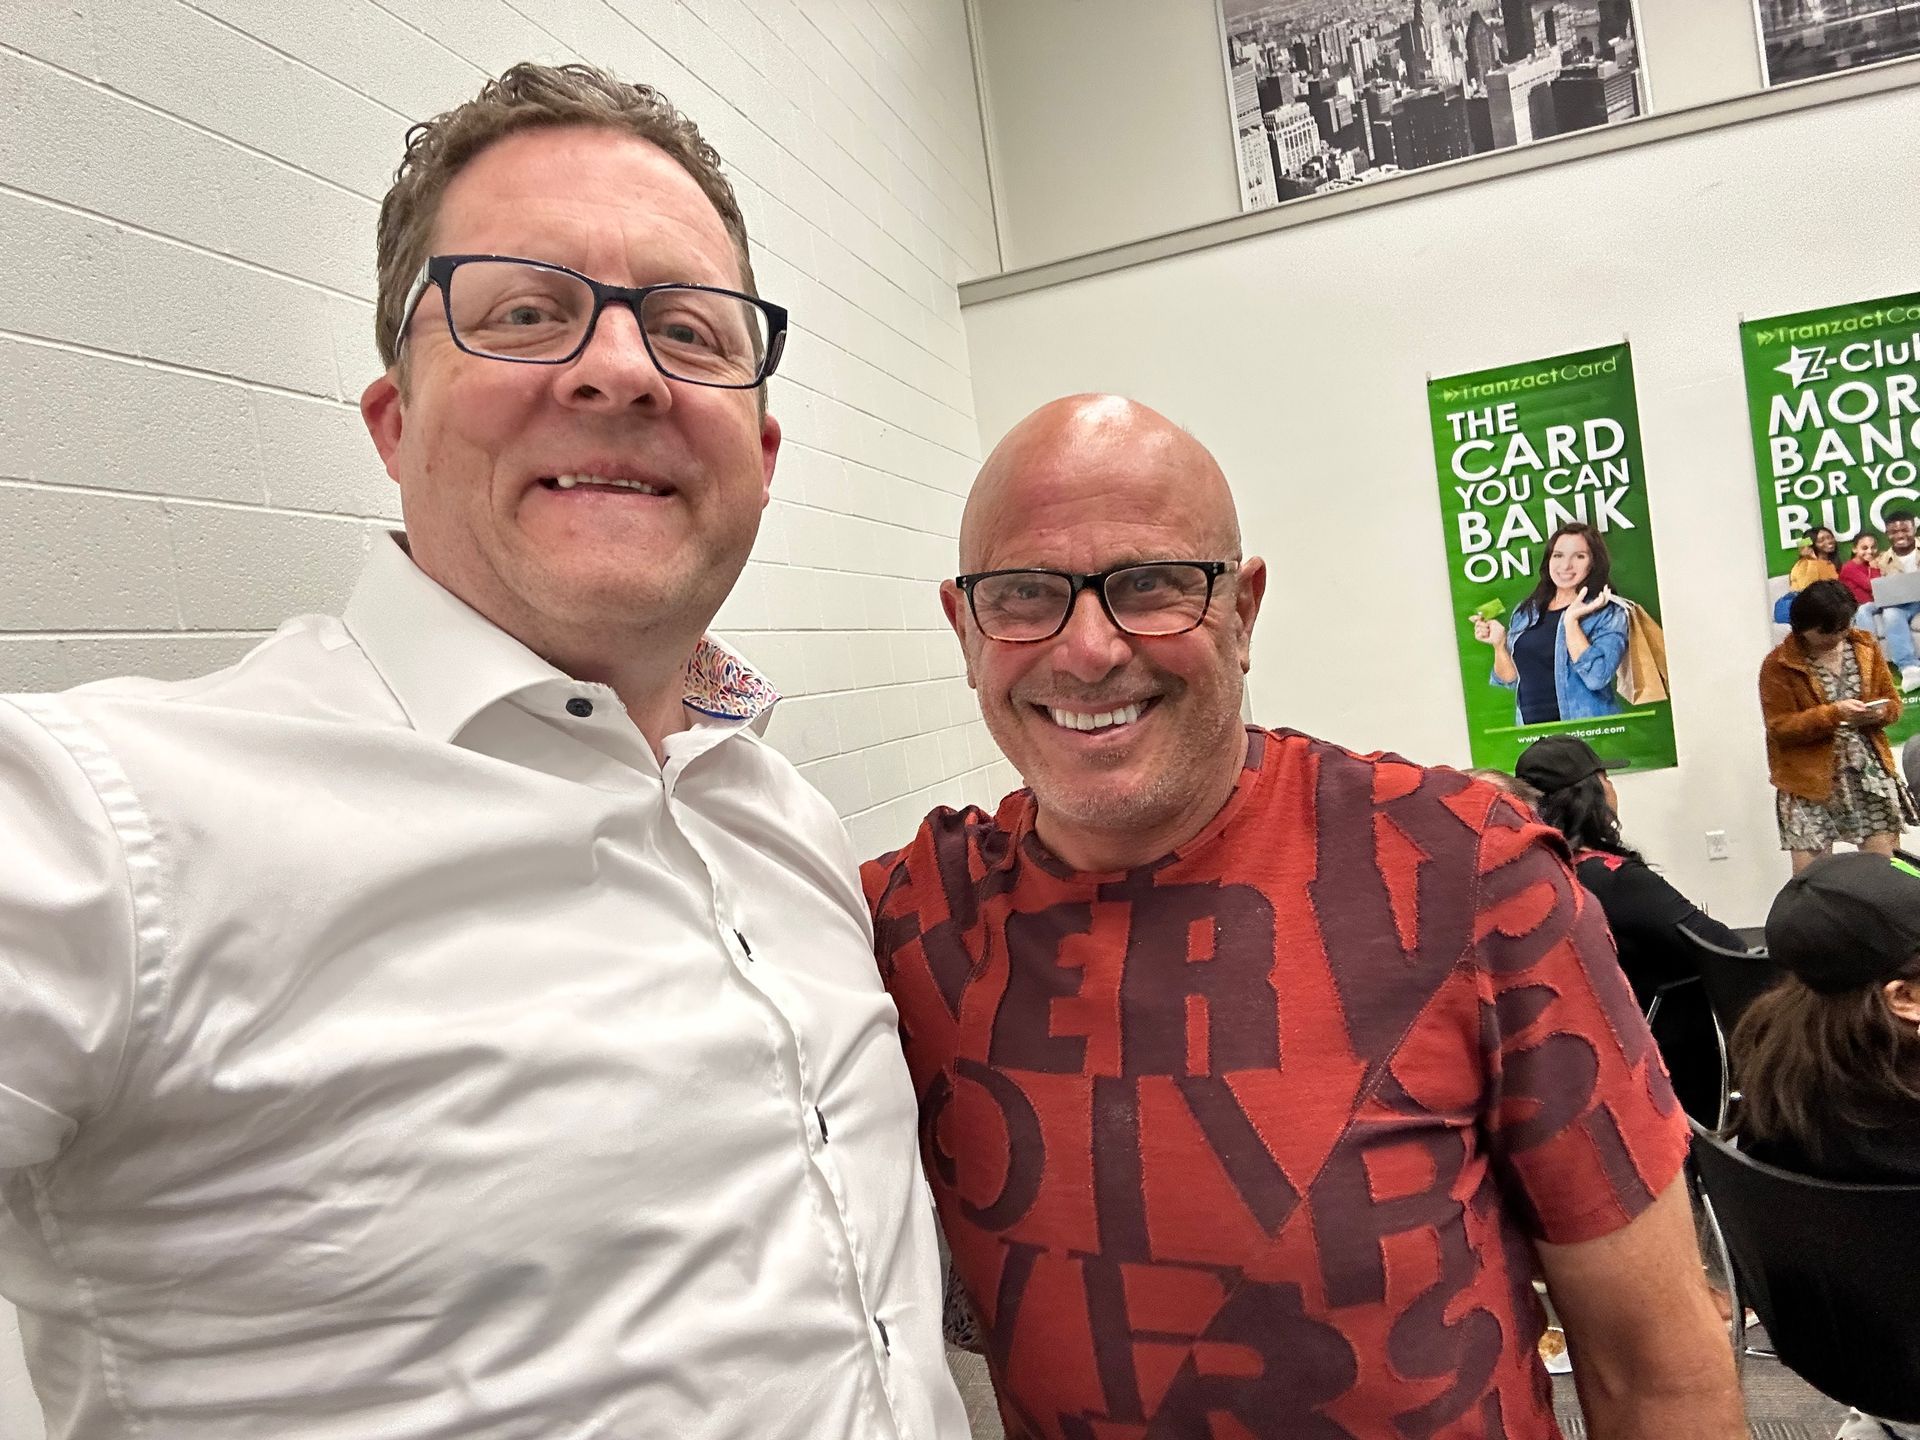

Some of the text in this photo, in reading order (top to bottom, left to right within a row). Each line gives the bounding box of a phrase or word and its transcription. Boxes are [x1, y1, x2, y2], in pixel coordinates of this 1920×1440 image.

[1459, 356, 1616, 399] TranzactCard
[1446, 402, 1519, 442] THE
[1451, 417, 1625, 482] CARD
[1770, 416, 1920, 477] BAN
[1455, 457, 1630, 510] YOU CAN
[1774, 470, 1849, 504] FOR
[1457, 485, 1635, 555] BANK
[1463, 547, 1530, 583] ON
